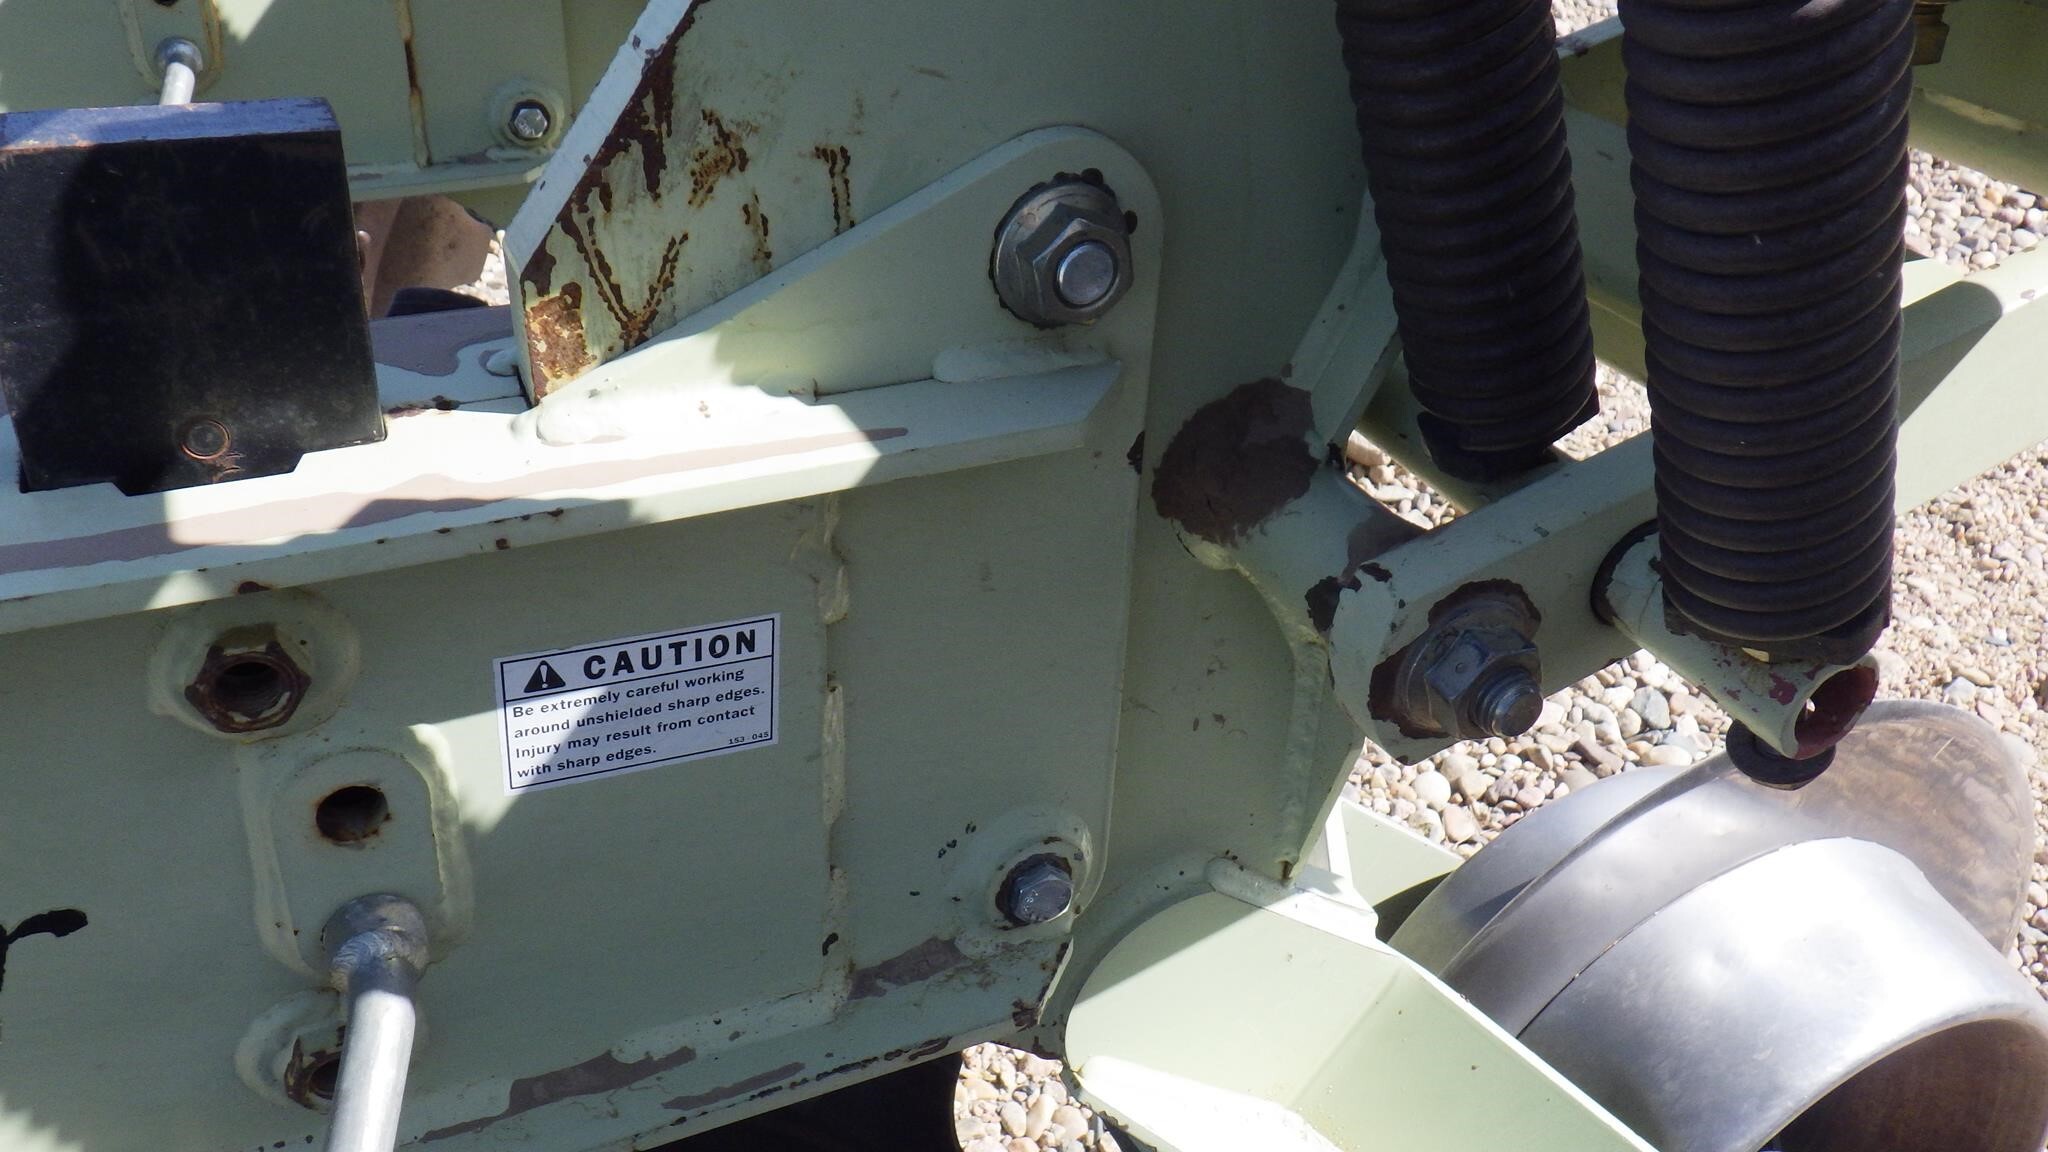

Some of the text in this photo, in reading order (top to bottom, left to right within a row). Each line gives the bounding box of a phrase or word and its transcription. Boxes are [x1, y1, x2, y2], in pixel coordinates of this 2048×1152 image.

[583, 629, 756, 680] CAUTION
[513, 669, 745, 718] Be extremely careful working
[514, 686, 765, 739] around unshielded sharp edges.
[516, 705, 756, 759] Injury may result from contact
[517, 745, 657, 778] with sharp edges.
